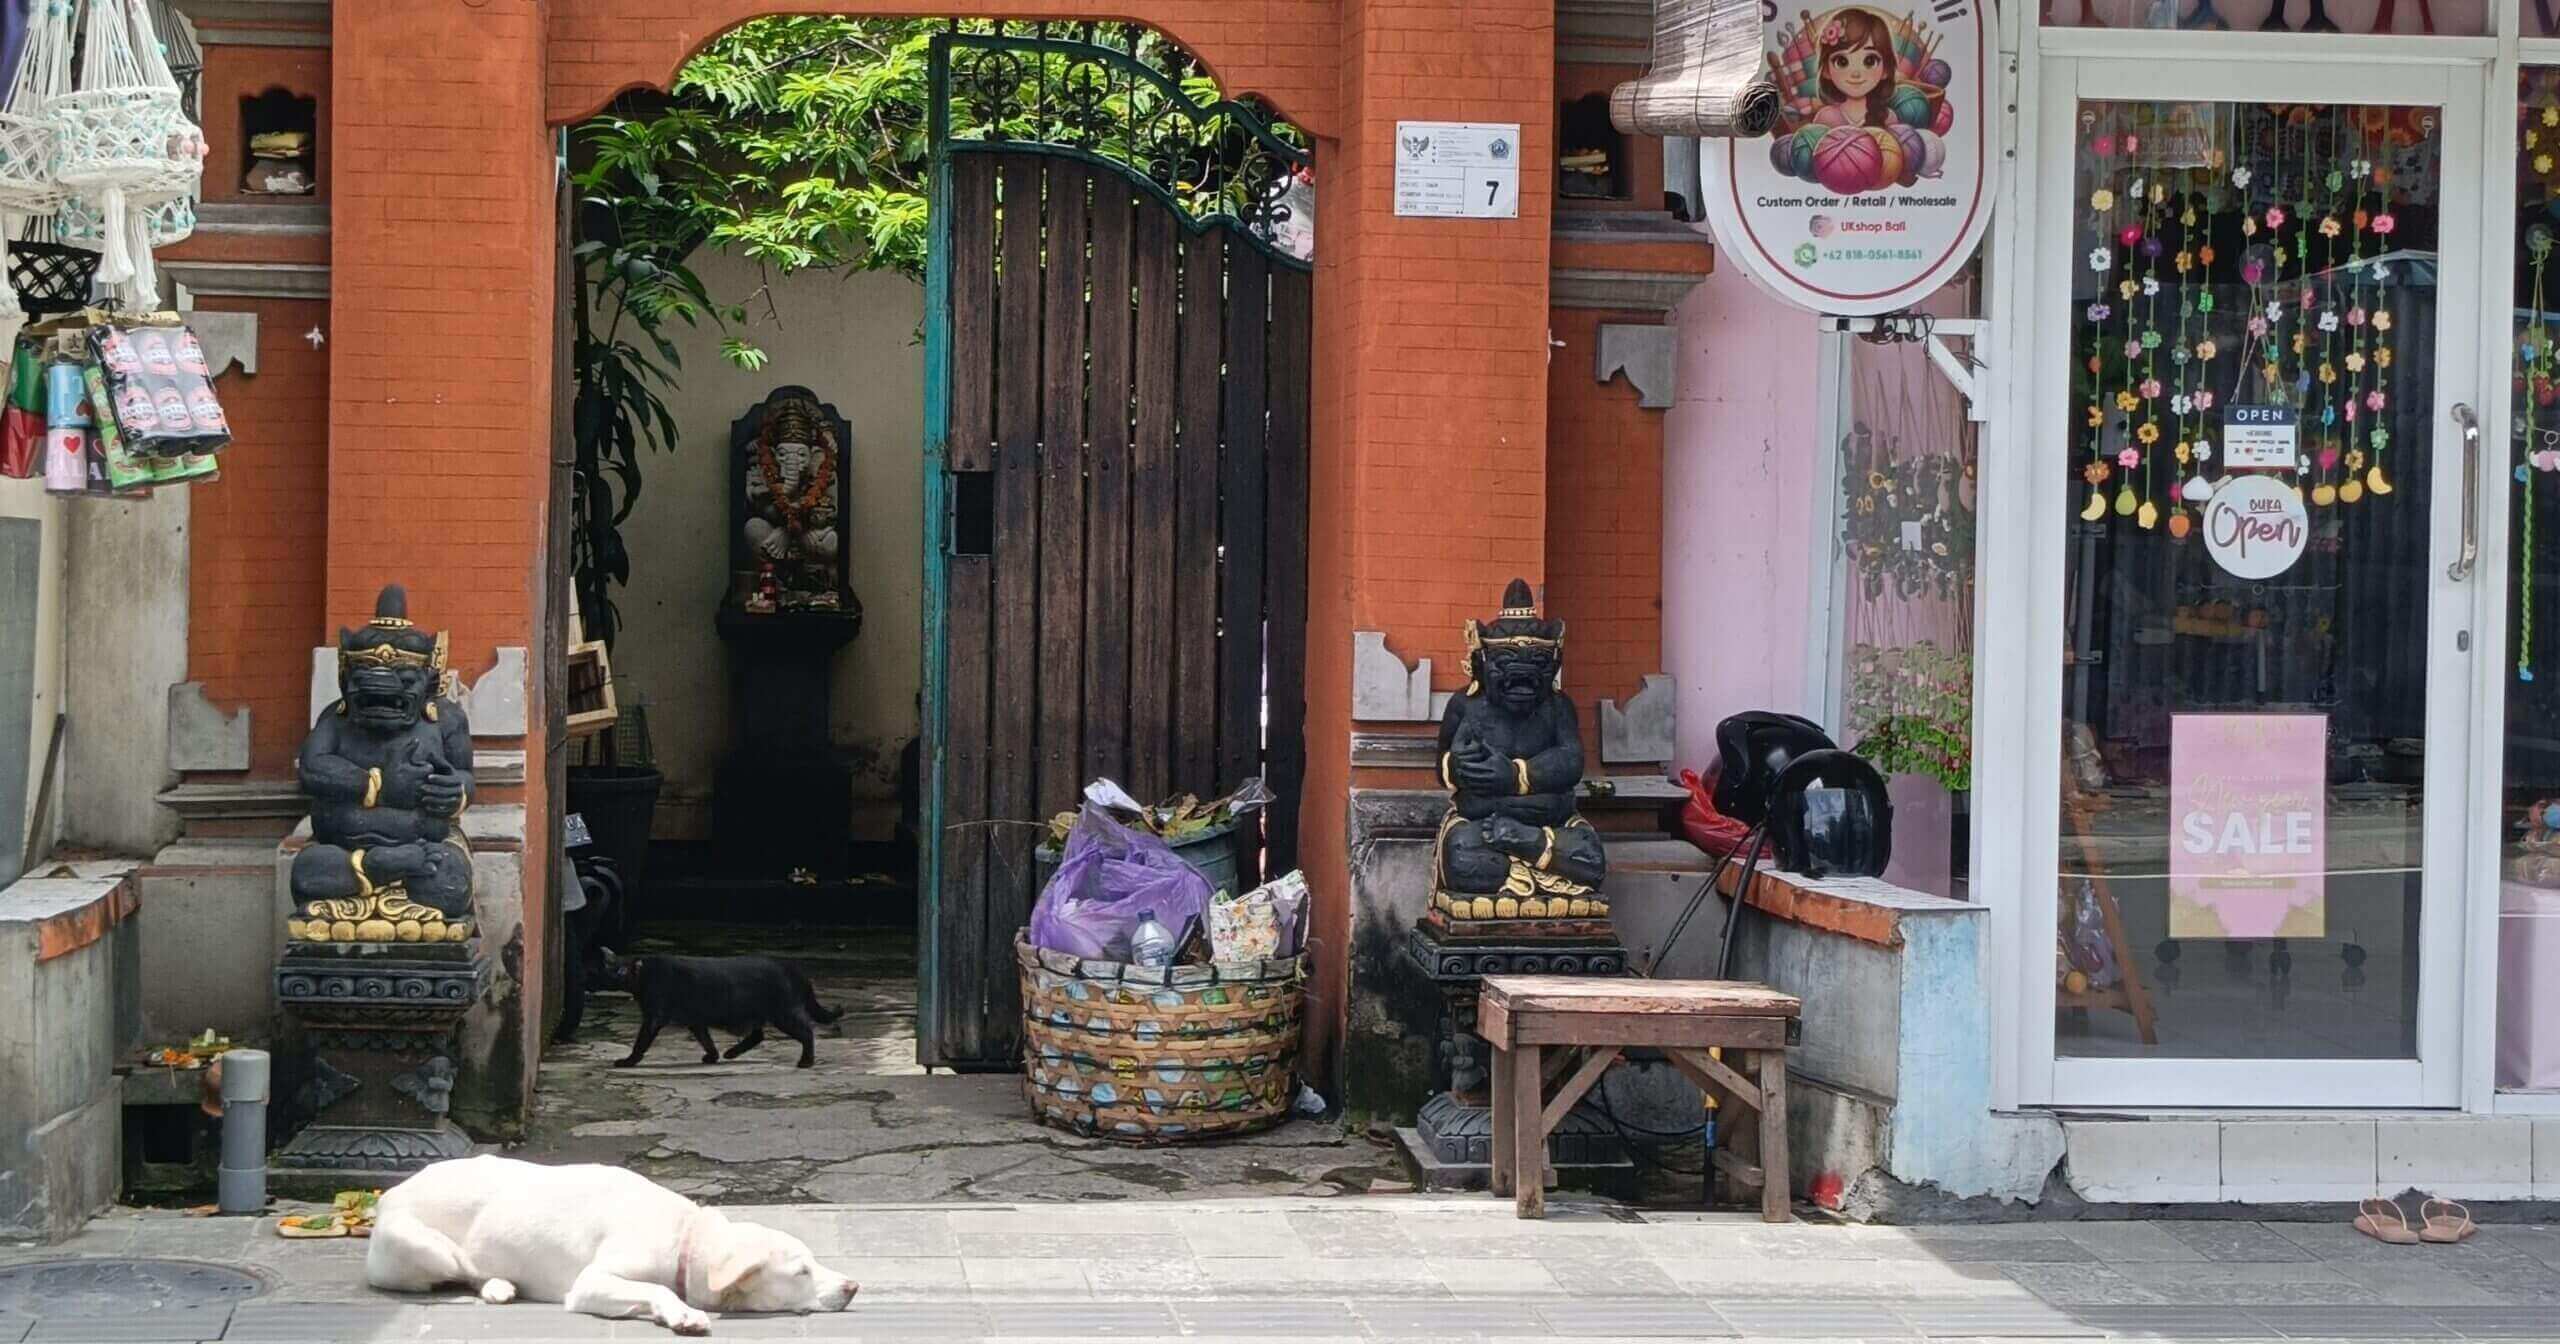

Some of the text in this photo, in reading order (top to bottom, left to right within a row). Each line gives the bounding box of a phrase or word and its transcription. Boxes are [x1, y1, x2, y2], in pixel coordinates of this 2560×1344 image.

[1485, 180, 1500, 207] 7
[1756, 196, 1802, 208] Custom
[1804, 196, 1841, 208] Order
[1852, 195, 1887, 207] Retail
[1898, 195, 1958, 207] Wholesale
[2235, 408, 2284, 422] OPEN
[2211, 501, 2301, 560] Open
[2182, 810, 2313, 855] SALE
